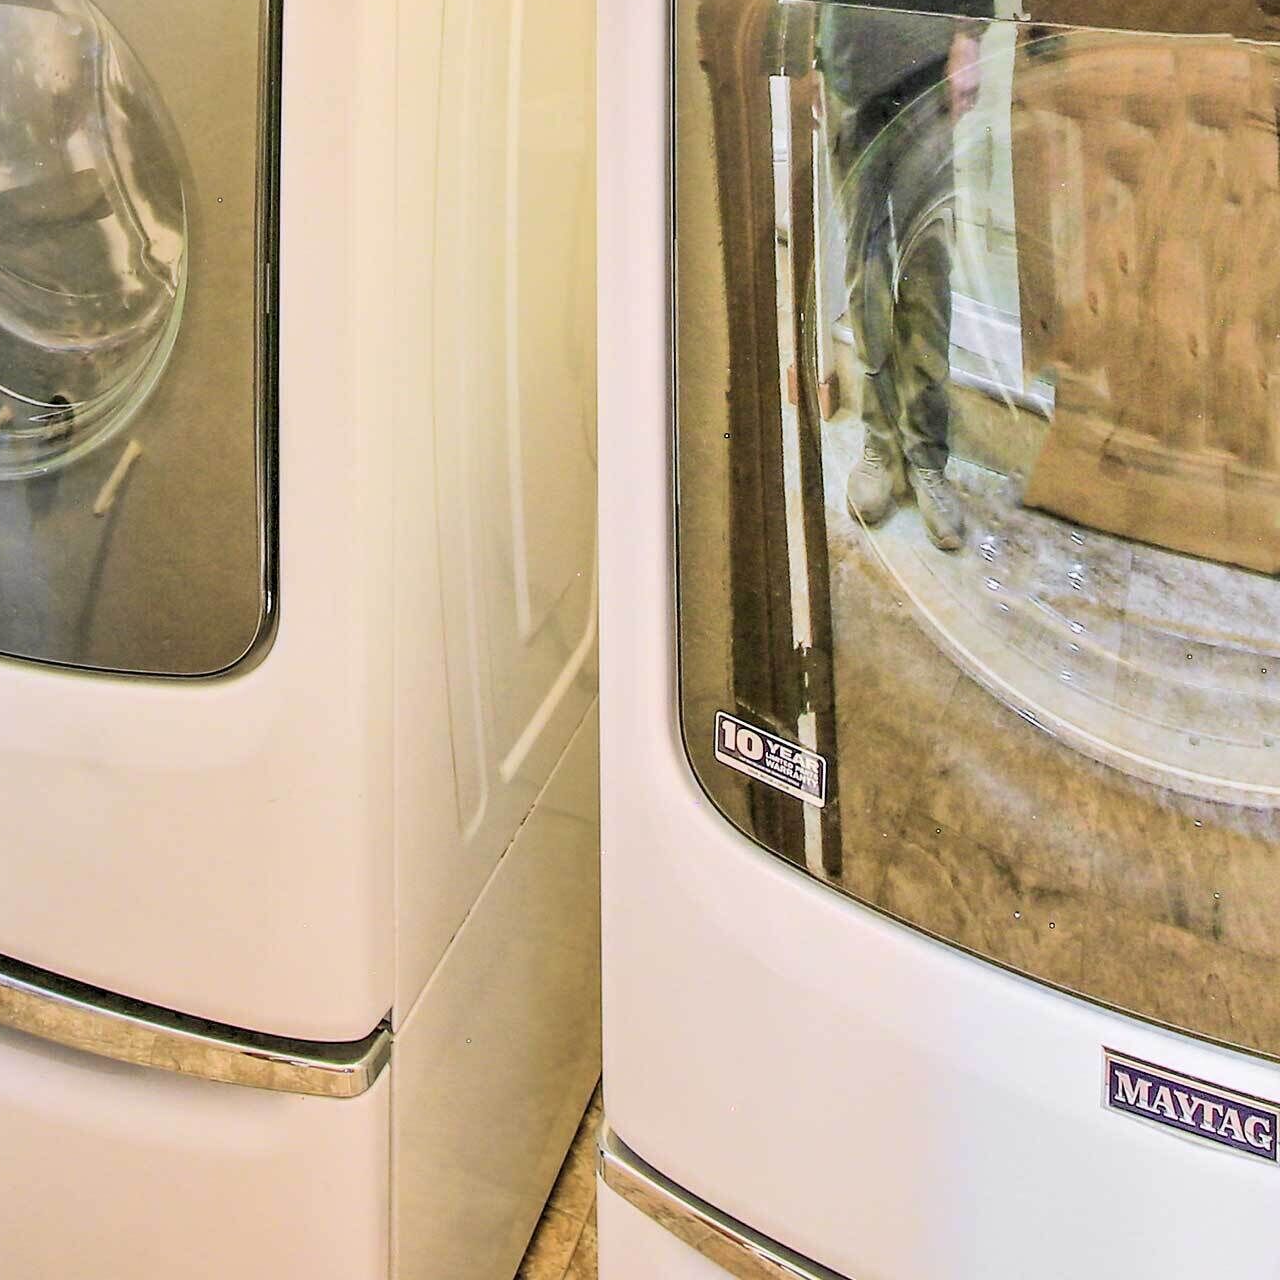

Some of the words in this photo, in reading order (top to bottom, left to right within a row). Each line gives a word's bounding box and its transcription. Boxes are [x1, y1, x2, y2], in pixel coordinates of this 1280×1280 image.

[721, 719, 763, 761] 10
[766, 739, 819, 774] YEAR
[765, 751, 794, 770] LIMITED
[765, 759, 819, 788] WARRANTY
[1114, 1070, 1273, 1151] MAYTAG
